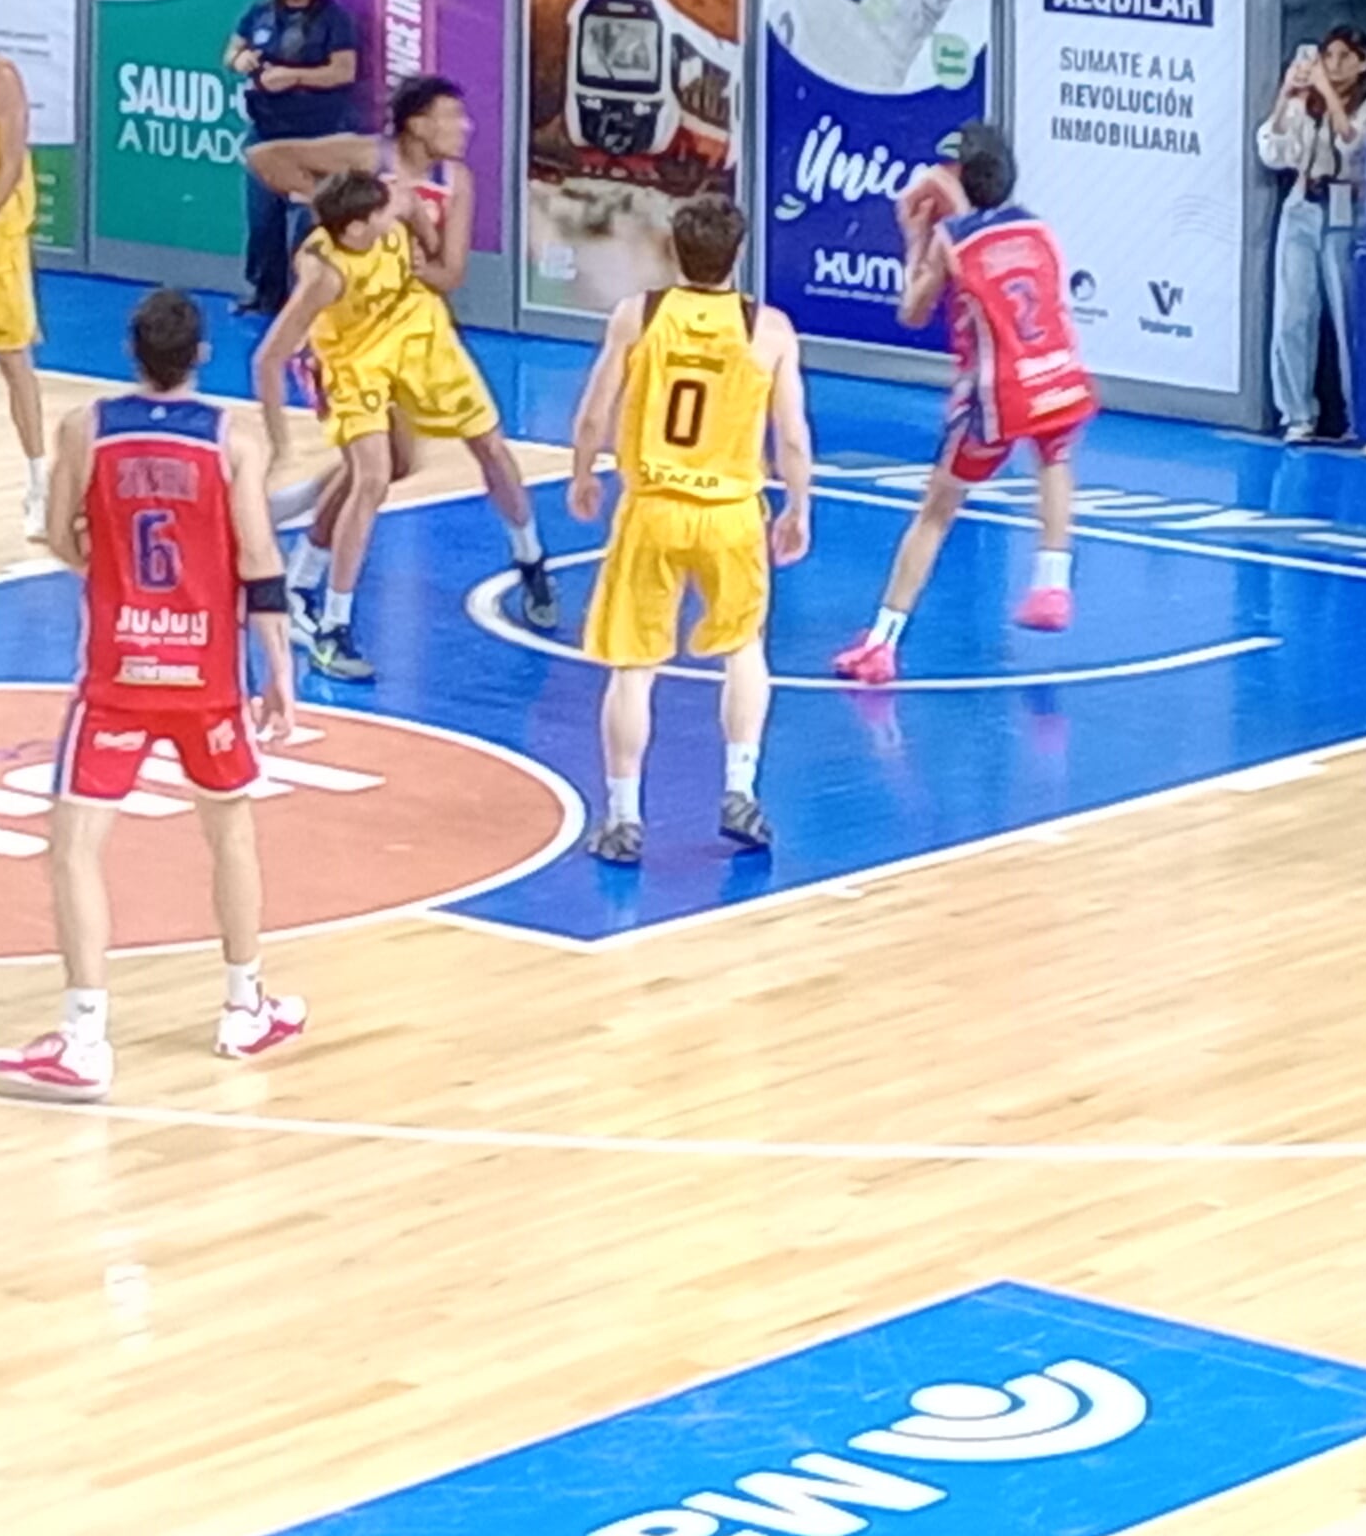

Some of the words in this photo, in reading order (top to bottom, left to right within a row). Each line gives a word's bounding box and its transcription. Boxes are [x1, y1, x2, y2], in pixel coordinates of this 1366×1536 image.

[1058, 46, 1143, 78] SUMATE
[1148, 56, 1163, 80] A
[1168, 58, 1196, 84] LA
[118, 62, 224, 123] SALUD
[1059, 81, 1195, 119] REVOLUCIÓN
[117, 119, 143, 153] A
[145, 120, 177, 157] TU
[1050, 116, 1202, 156] INMOBILIARIA
[664, 378, 708, 449] 0
[131, 508, 184, 593] 6
